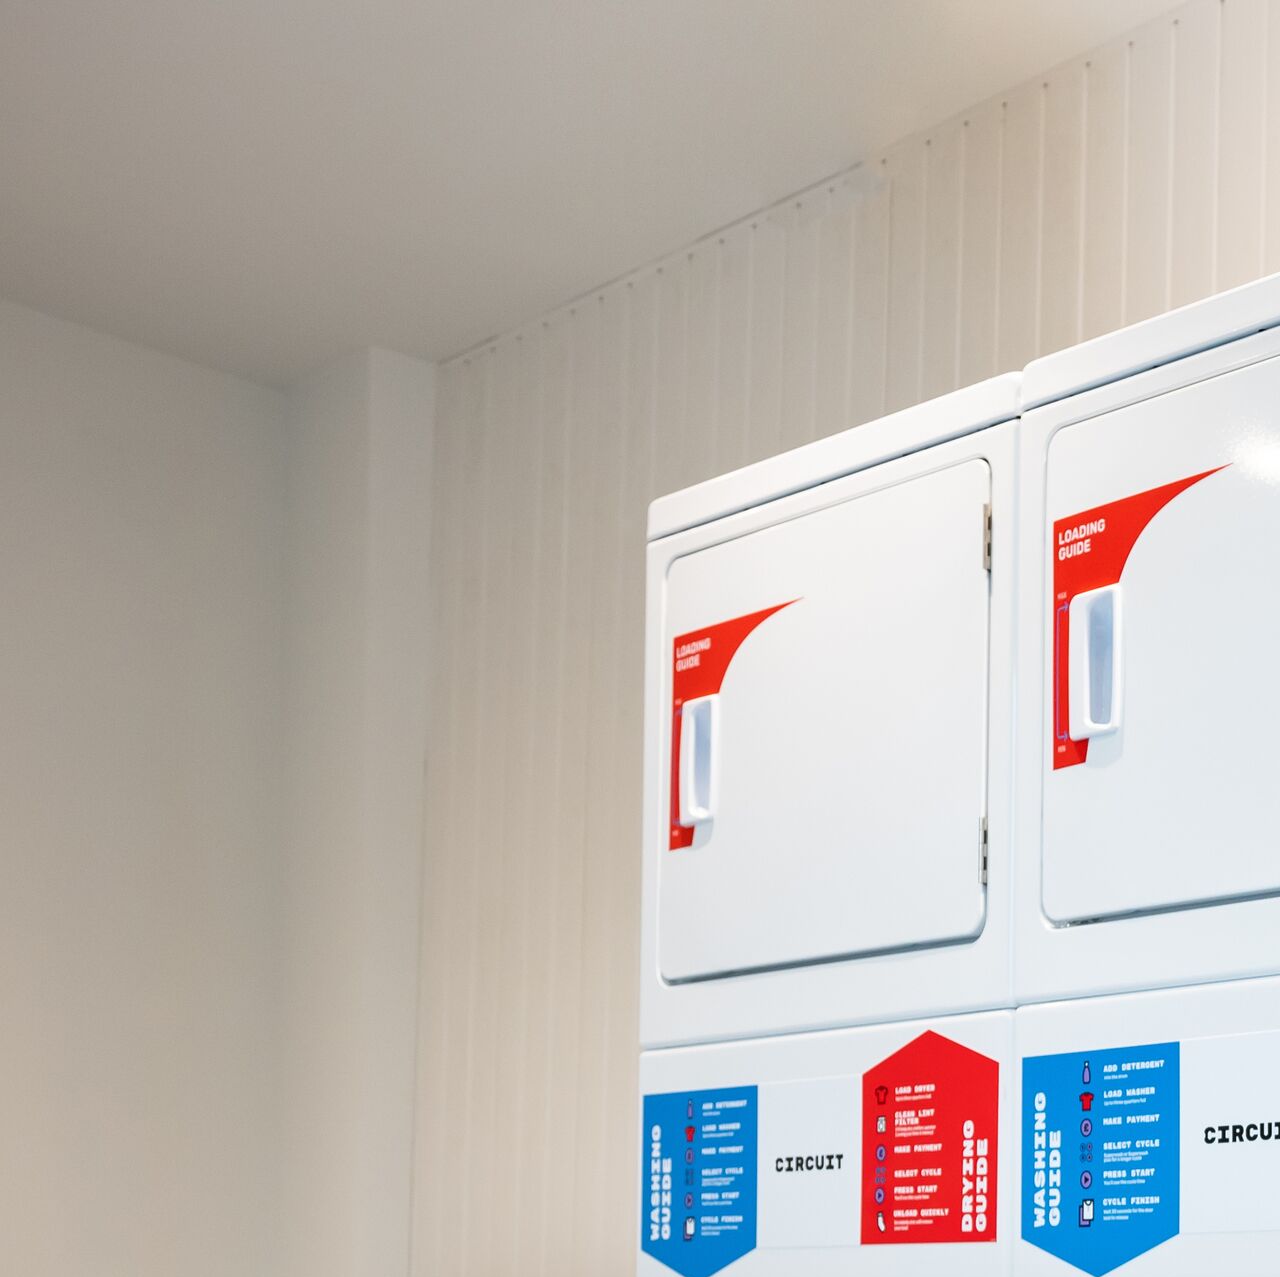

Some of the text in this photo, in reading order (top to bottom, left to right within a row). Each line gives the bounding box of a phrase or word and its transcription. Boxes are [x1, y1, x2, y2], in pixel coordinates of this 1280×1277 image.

[1057, 517, 1105, 545] LOADING
[1059, 539, 1091, 560] GUIDE
[676, 638, 711, 658] LOADING
[676, 653, 700, 671] GUIDE
[651, 1125, 661, 1240] WASHING
[661, 1158, 672, 1240] GUIDE
[776, 1154, 843, 1172] CIRCUIT
[962, 1120, 974, 1232] DRYING
[976, 1139, 988, 1232] GUIDE
[1034, 1093, 1046, 1227] WASHING
[1049, 1131, 1061, 1226] GUIDE
